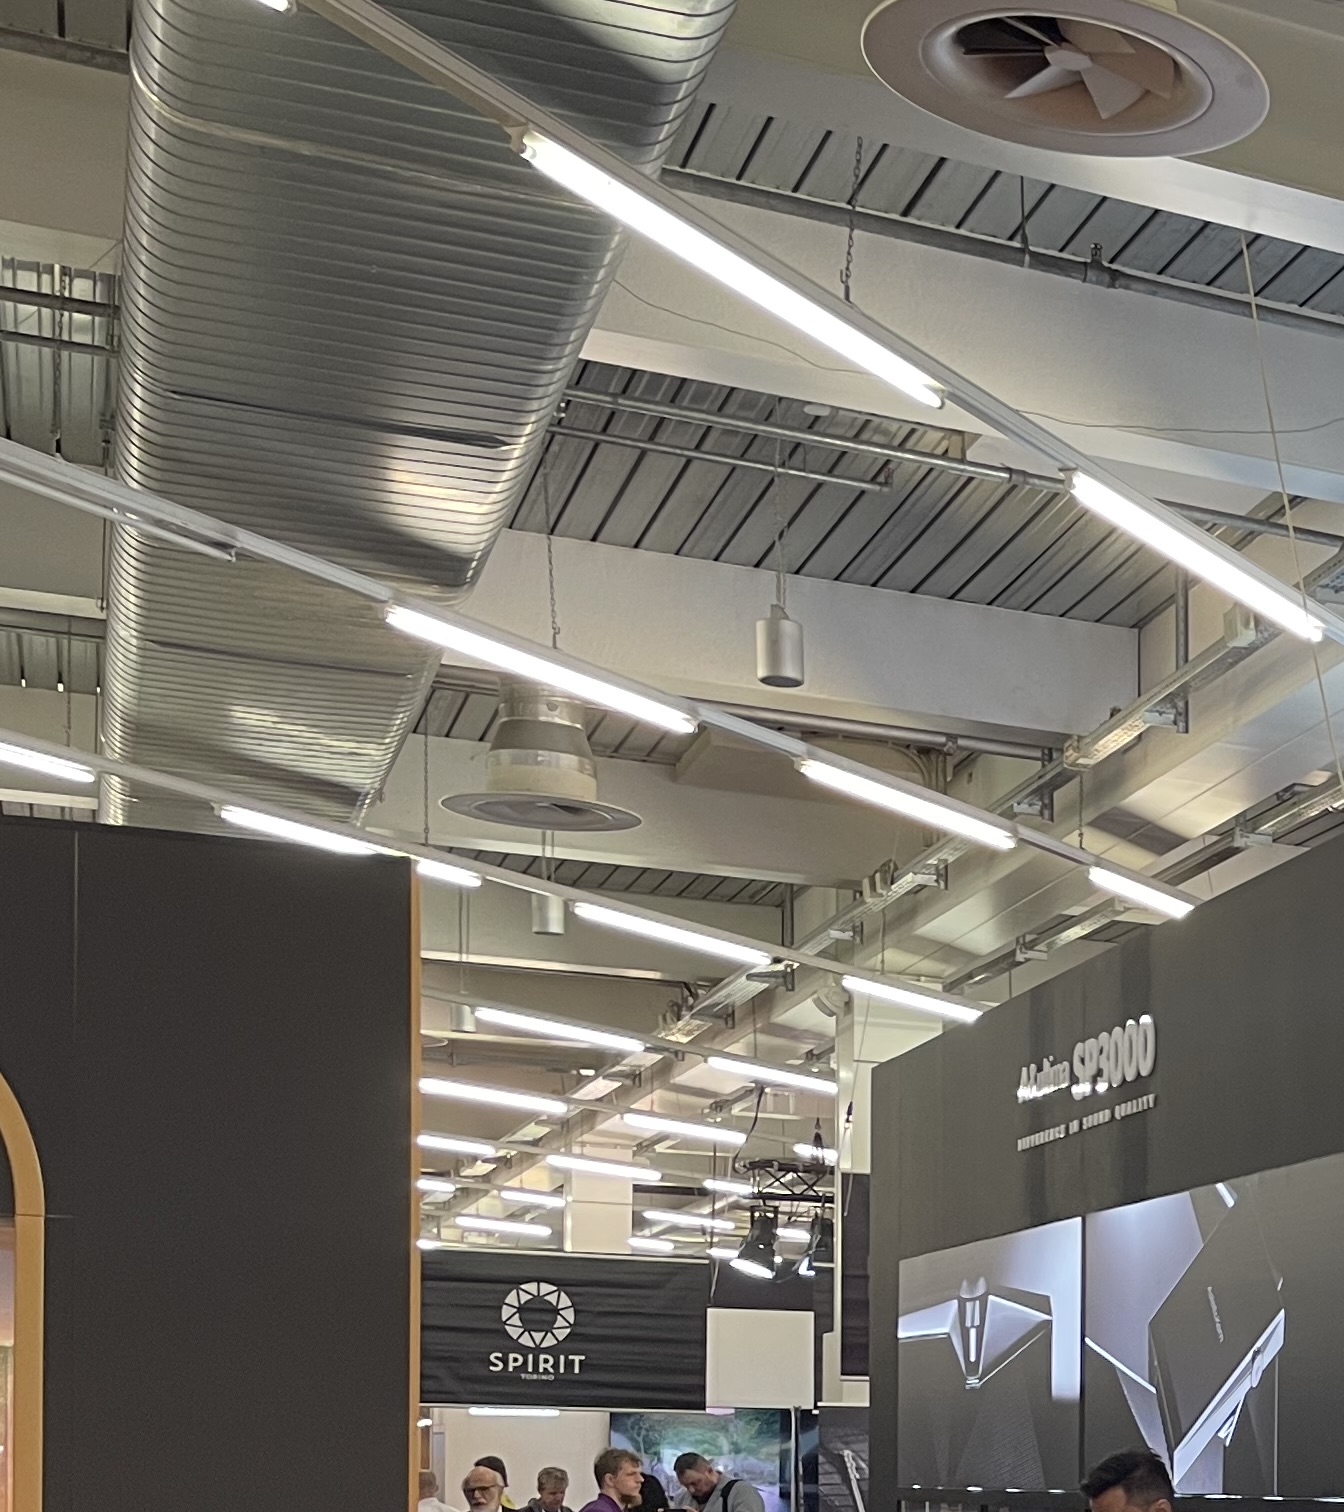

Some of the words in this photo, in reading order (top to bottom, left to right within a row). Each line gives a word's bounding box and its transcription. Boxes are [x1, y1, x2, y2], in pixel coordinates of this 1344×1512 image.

[1071, 1014, 1156, 1101] SP3000
[1114, 1093, 1156, 1120] QUALITY
[489, 1352, 586, 1374] SPIRIT
